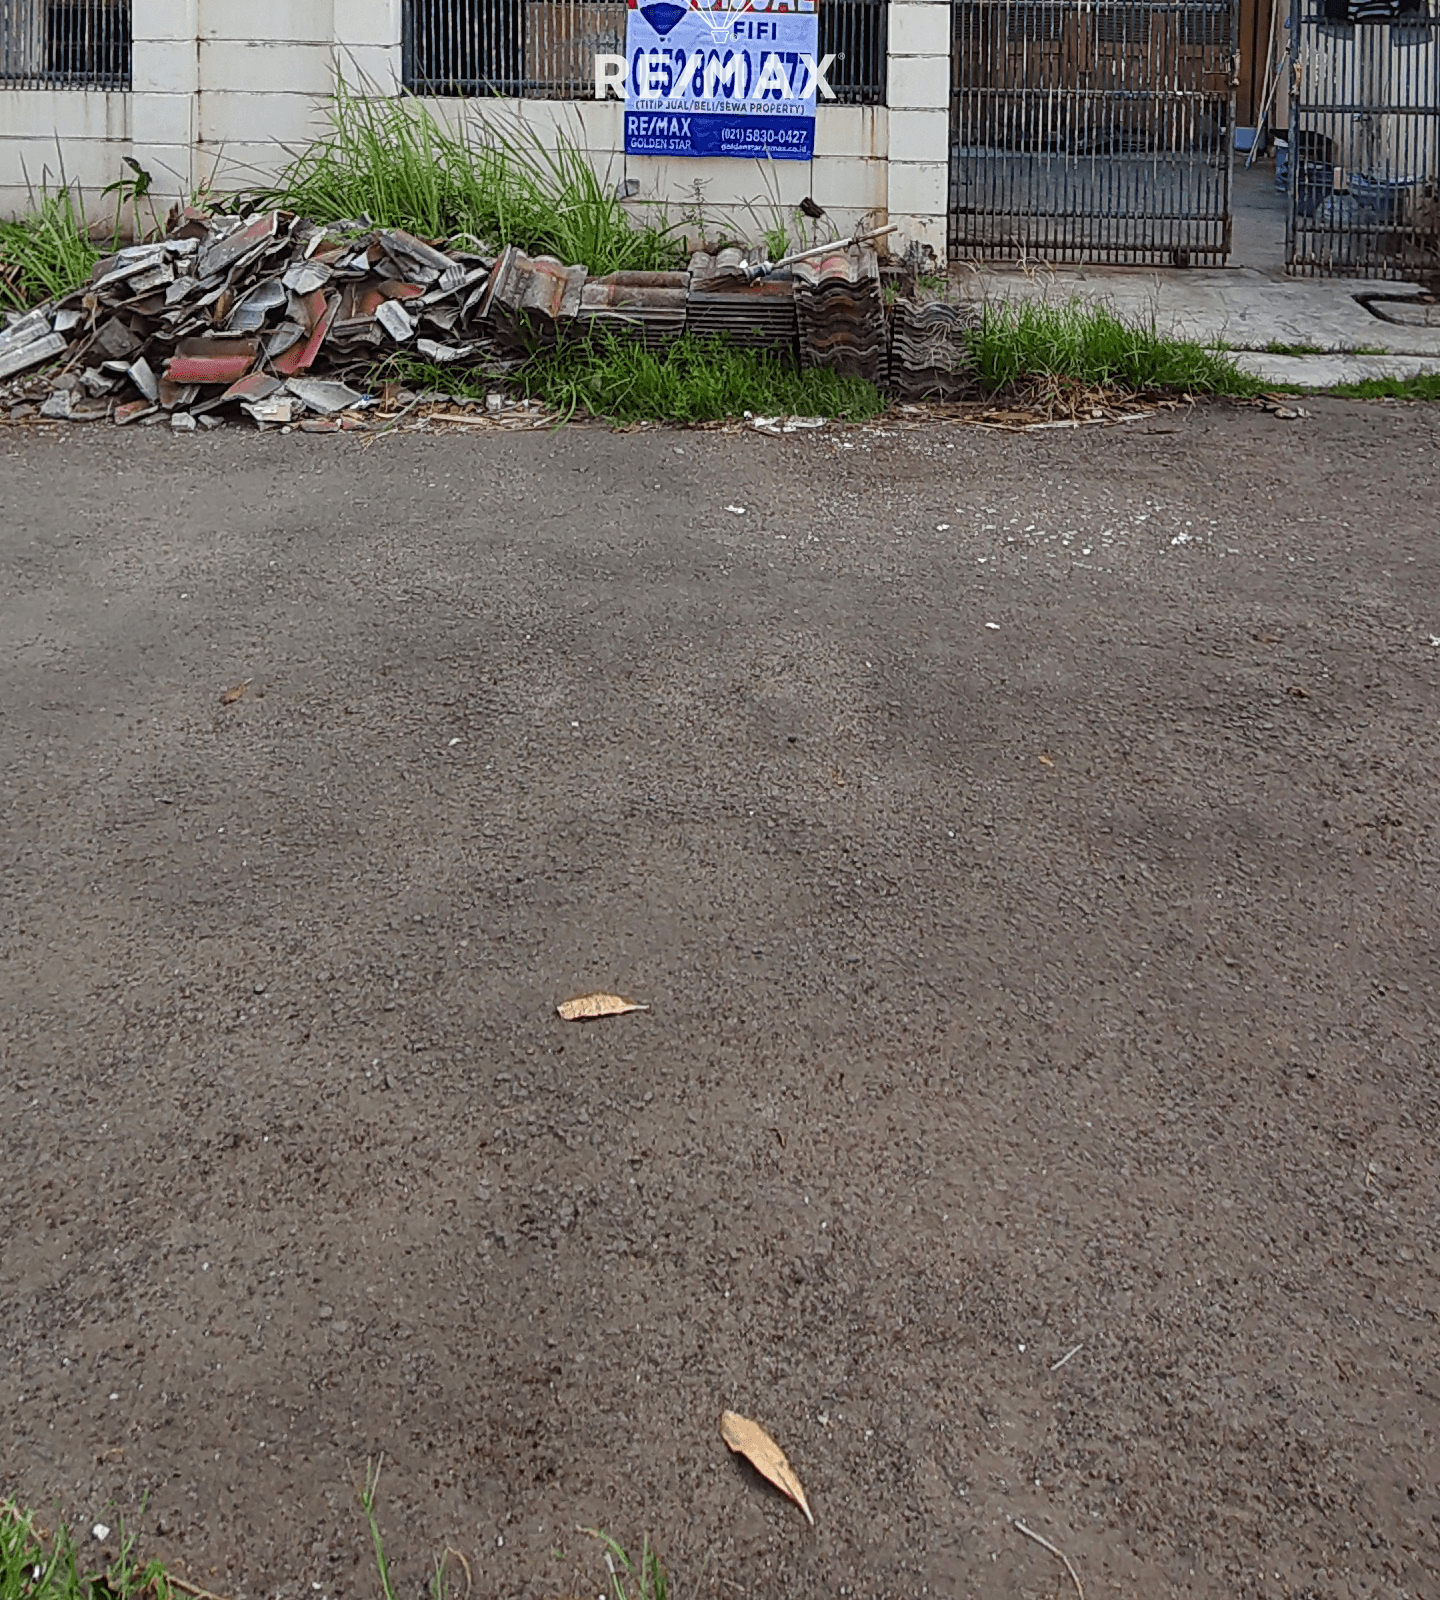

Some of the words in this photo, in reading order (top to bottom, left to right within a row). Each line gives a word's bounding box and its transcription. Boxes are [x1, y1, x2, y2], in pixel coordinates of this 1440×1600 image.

[733, 21, 777, 40] FIFI
[635, 100, 663, 110] (TITIP
[665, 100, 747, 112] JUAL/BELI/SEWA
[627, 116, 692, 137] RE/MAX
[721, 128, 744, 143] (021)
[745, 129, 807, 143] 5830-0427
[630, 138, 668, 149] GOLDEN
[669, 139, 692, 150] STAR
